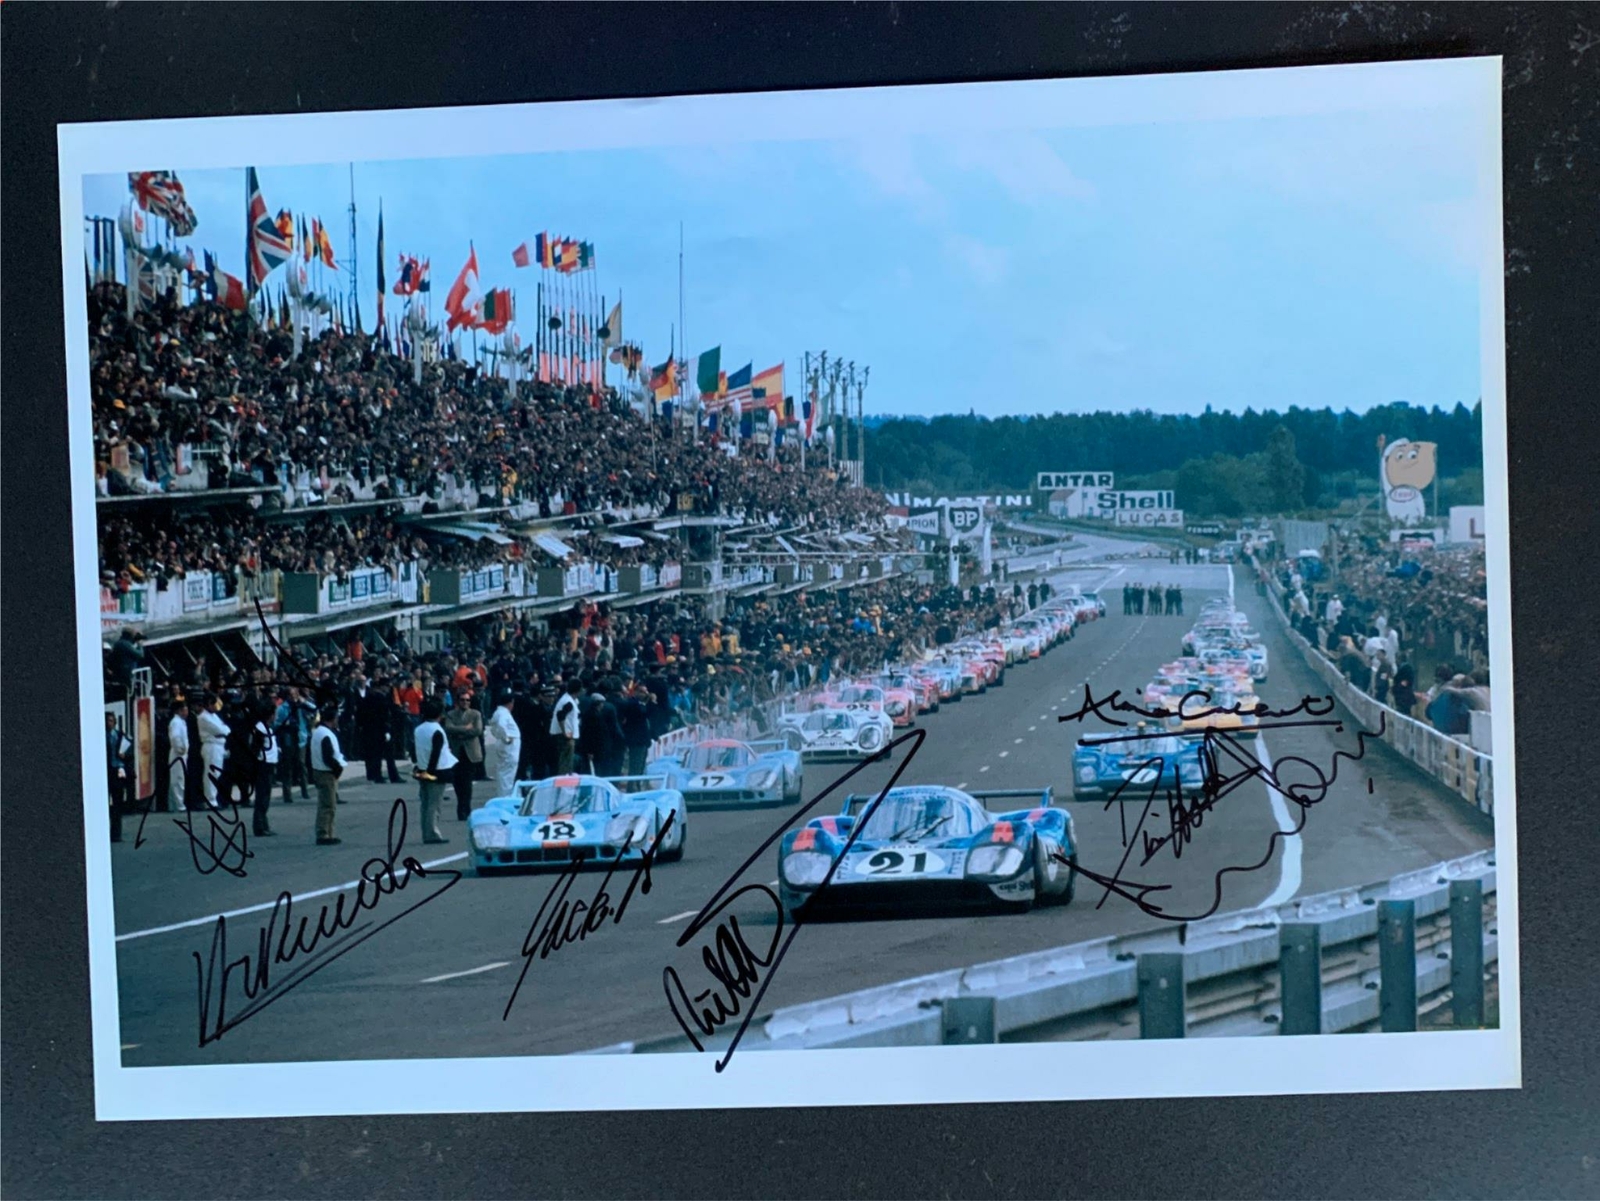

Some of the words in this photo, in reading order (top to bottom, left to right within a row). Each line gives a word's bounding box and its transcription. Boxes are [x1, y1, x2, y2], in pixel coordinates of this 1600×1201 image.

[1040, 474, 1112, 488] ANTAR
[1097, 492, 1172, 509] Shell
[952, 510, 978, 527] BP
[1118, 513, 1181, 526] LUCAS
[700, 776, 724, 787] 17
[868, 850, 927, 874] 21
